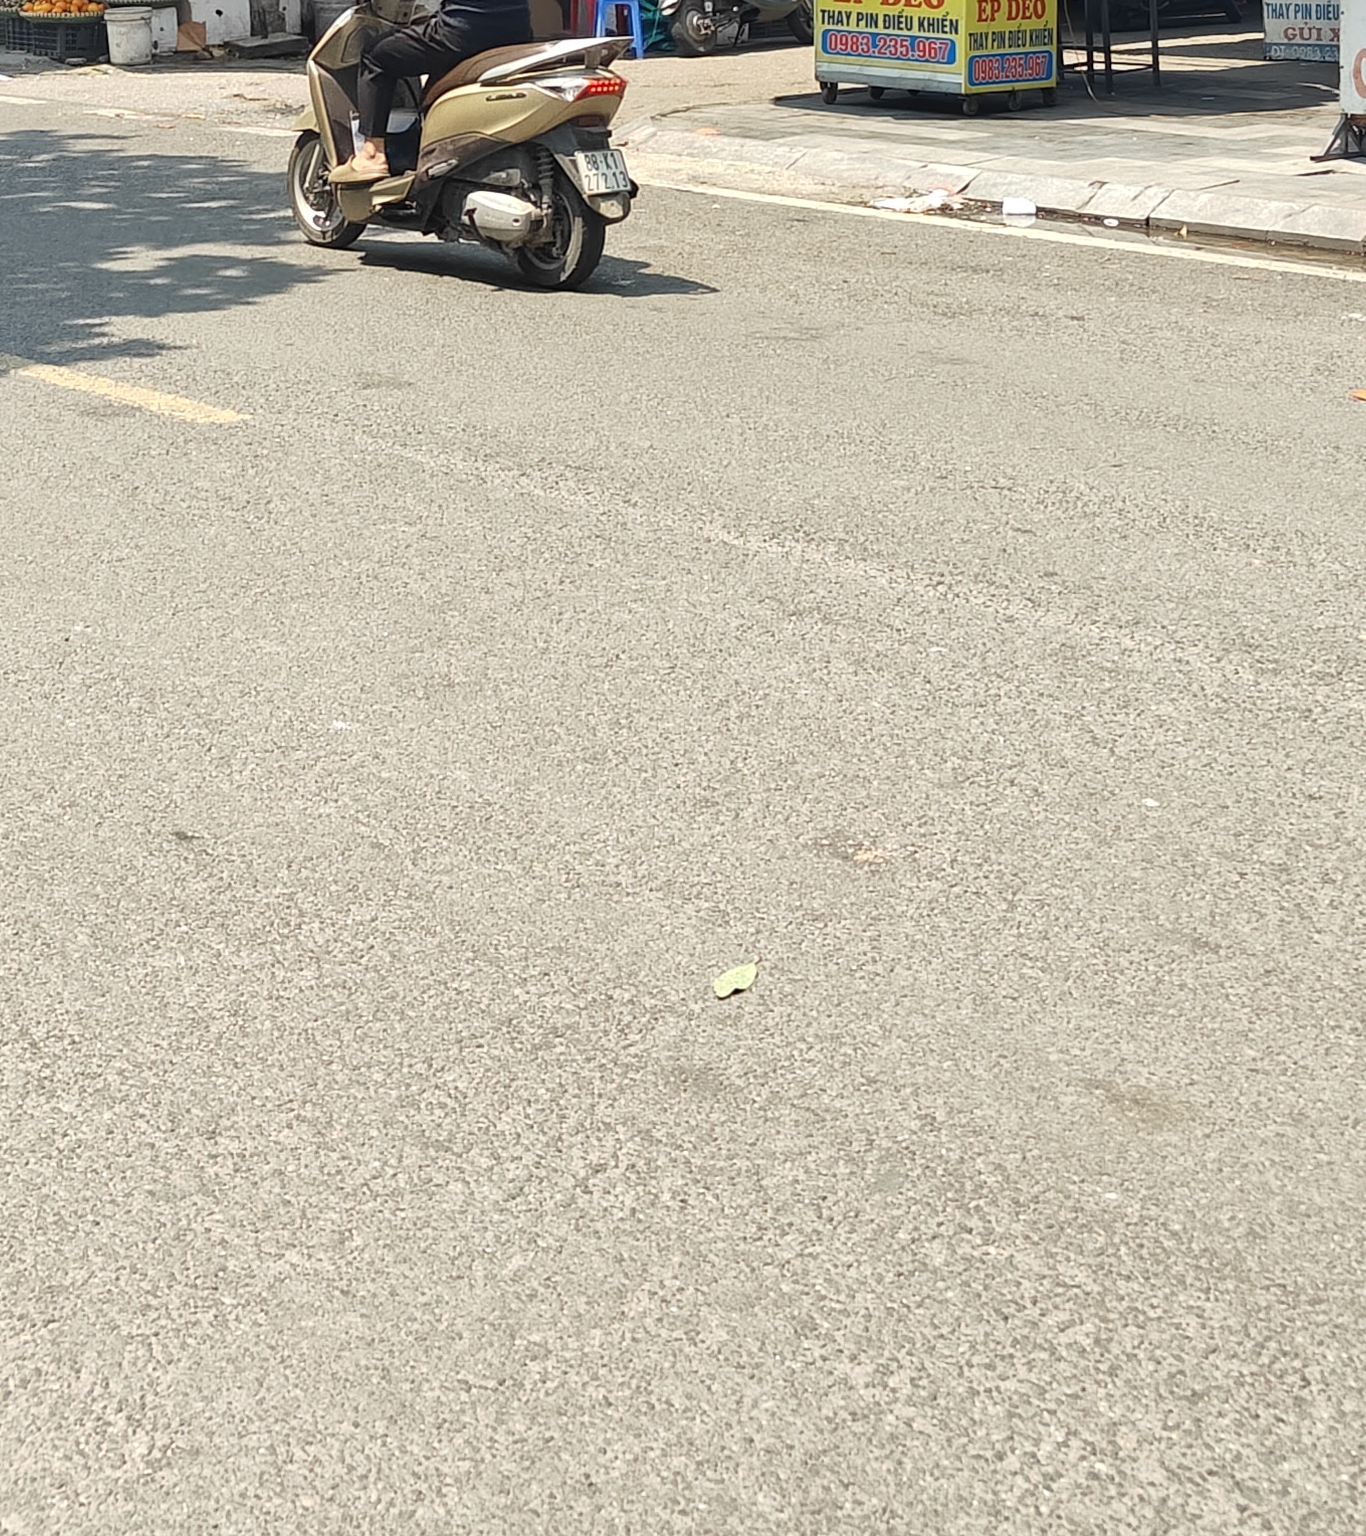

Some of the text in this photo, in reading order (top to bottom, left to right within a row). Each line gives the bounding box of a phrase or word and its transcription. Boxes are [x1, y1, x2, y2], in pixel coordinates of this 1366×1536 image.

[820, 9, 959, 35] THAY PIN ĐIỀU KHIỂN
[1265, 2, 1292, 20] THAY
[1294, 3, 1312, 20] PIN
[969, 20, 1054, 51] THAY PIN ĐIỀU KHIỂN
[1283, 22, 1322, 41] GỬI
[827, 32, 949, 60] 0983.235.967
[973, 54, 1048, 82] 0983.235.967
[585, 171, 629, 193] 272.13
